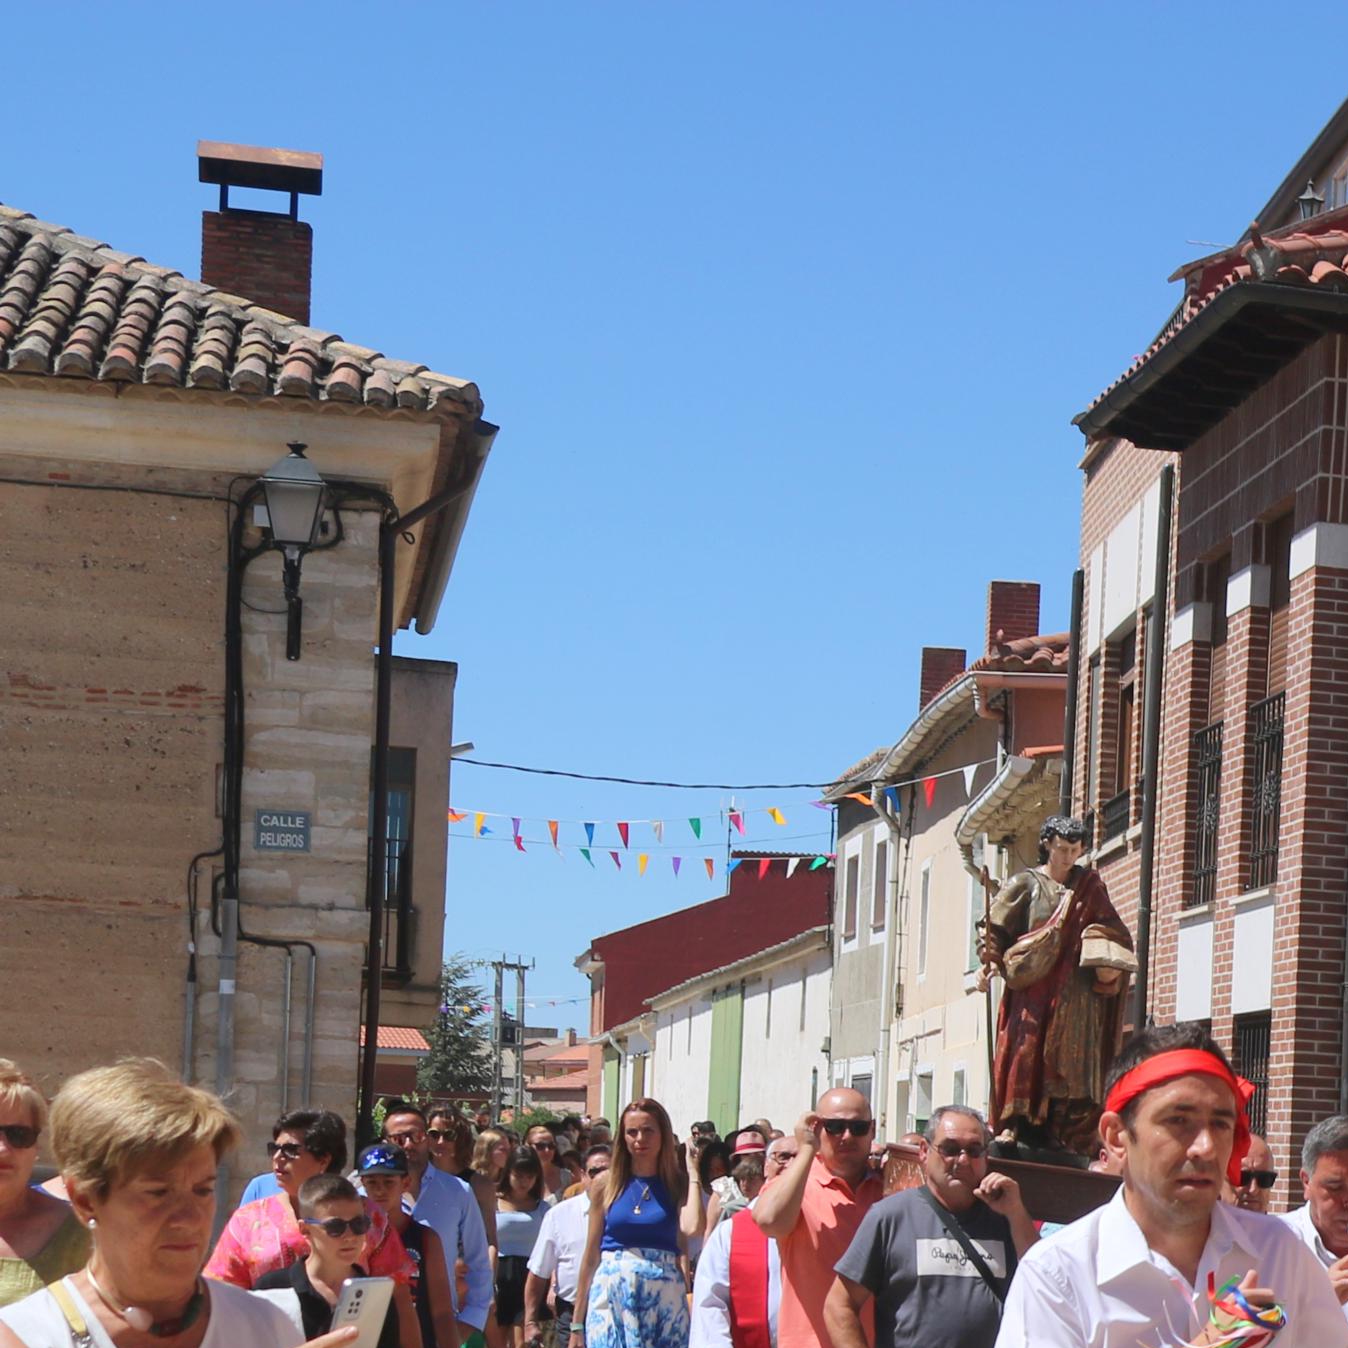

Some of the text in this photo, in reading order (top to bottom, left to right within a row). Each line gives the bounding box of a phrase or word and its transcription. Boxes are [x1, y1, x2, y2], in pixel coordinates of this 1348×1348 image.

[261, 815, 304, 828] CALLE
[260, 832, 304, 848] PELIGROS
[959, 1249, 995, 1266] Jns
